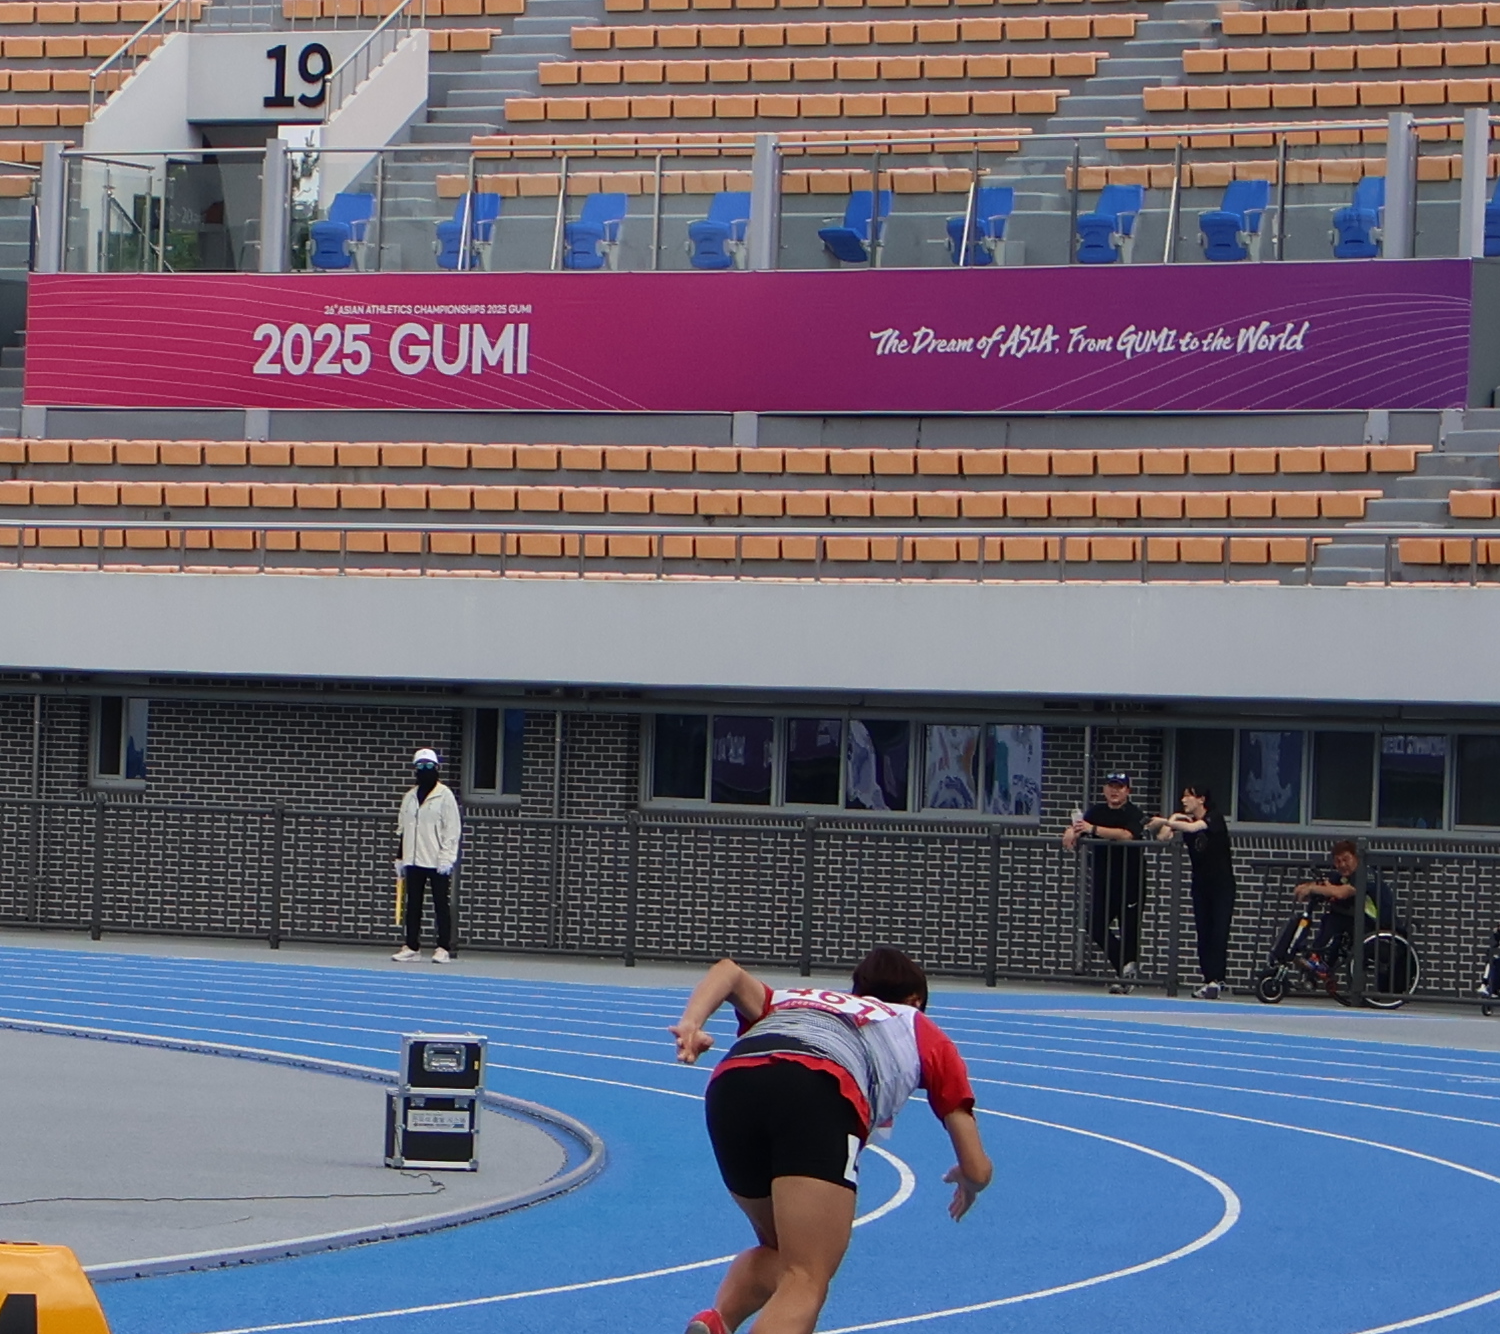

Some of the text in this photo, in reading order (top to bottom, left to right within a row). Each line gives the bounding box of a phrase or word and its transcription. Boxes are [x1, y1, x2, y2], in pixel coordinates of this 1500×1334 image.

[263, 42, 333, 107] 19
[338, 305, 365, 315] ASIAN
[365, 305, 413, 315] ATHLETICS
[413, 304, 486, 314] CHAMPIONSHIPS
[486, 304, 507, 314] 2025
[508, 304, 533, 314] GUMI
[252, 322, 529, 375] 2025 GUMI
[869, 328, 911, 355] The
[911, 326, 974, 354] Dream
[976, 325, 1006, 359] of
[1067, 325, 1114, 354] From
[1116, 325, 1178, 360] GUMI
[1178, 332, 1200, 352] to
[1201, 328, 1235, 352] the
[1235, 321, 1310, 353] World
